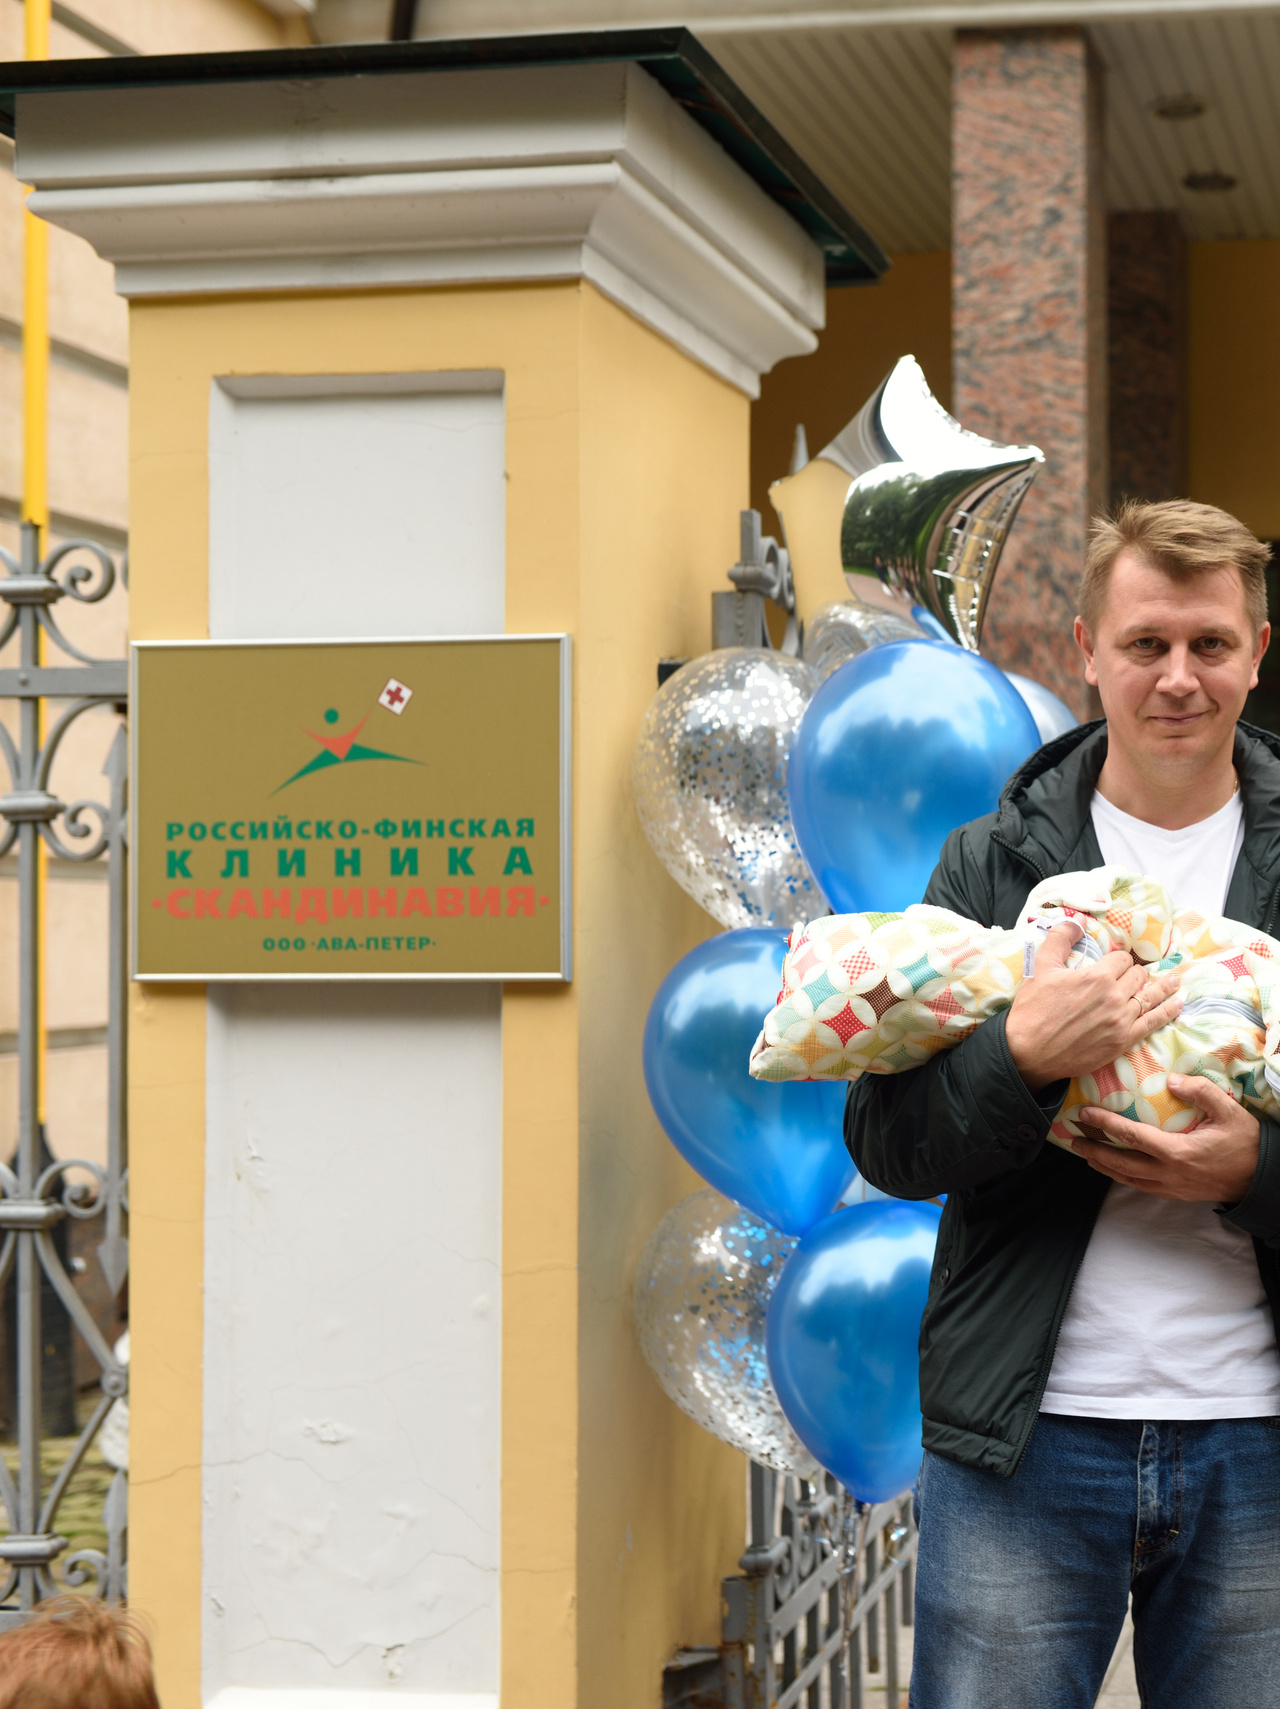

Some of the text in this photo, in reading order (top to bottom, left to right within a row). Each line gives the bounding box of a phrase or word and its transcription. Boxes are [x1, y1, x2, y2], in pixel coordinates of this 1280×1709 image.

[166, 815, 535, 841] РОССИЙСКО-ФИНСКАЯ
[166, 846, 534, 879] КЛИНИКА
[262, 937, 306, 951] ООО
